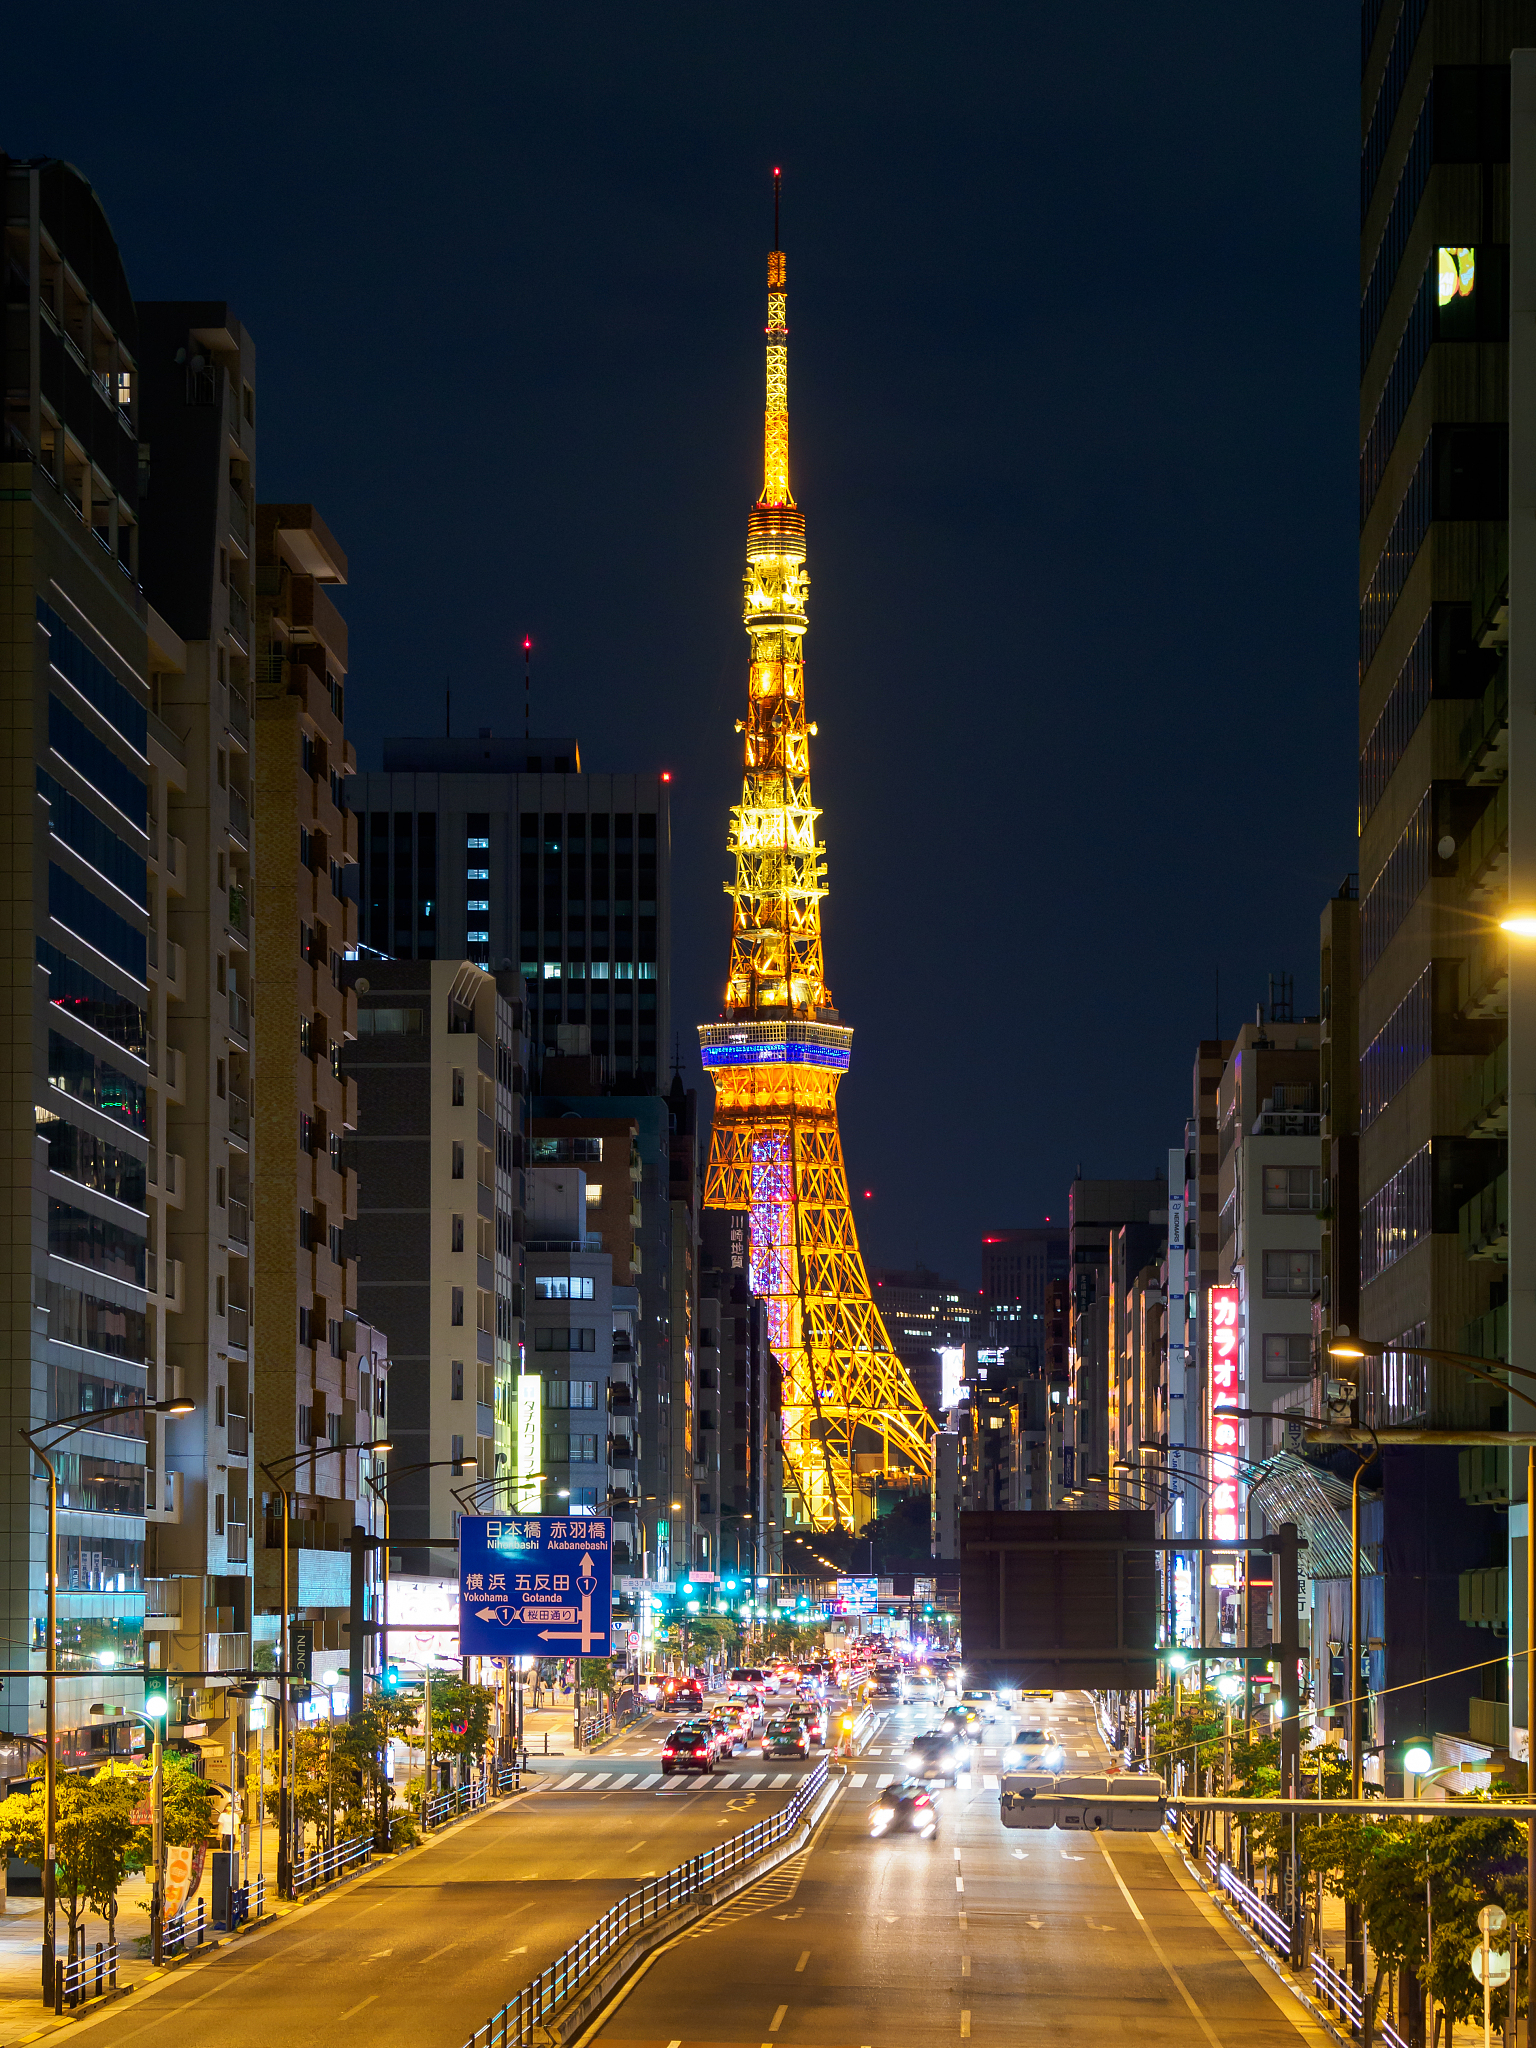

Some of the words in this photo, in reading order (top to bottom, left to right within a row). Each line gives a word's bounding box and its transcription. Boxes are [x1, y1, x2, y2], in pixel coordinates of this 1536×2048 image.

[730, 1215, 744, 1269] 川崎地質
[486, 1521, 541, 1539] 日本橋
[550, 1521, 606, 1539] 赤羽橋
[487, 1540, 539, 1550] Nihonbashi
[547, 1540, 608, 1551] Akabanebashi
[466, 1573, 506, 1591] 横浜
[514, 1574, 570, 1591] 五反田
[583, 1579, 589, 1591] 1
[463, 1592, 508, 1602] Yokohama
[522, 1593, 562, 1603] Gotanda
[502, 1608, 508, 1620] 1
[527, 1610, 573, 1621] 桜田通り
[296, 1635, 306, 1670] NUNC
